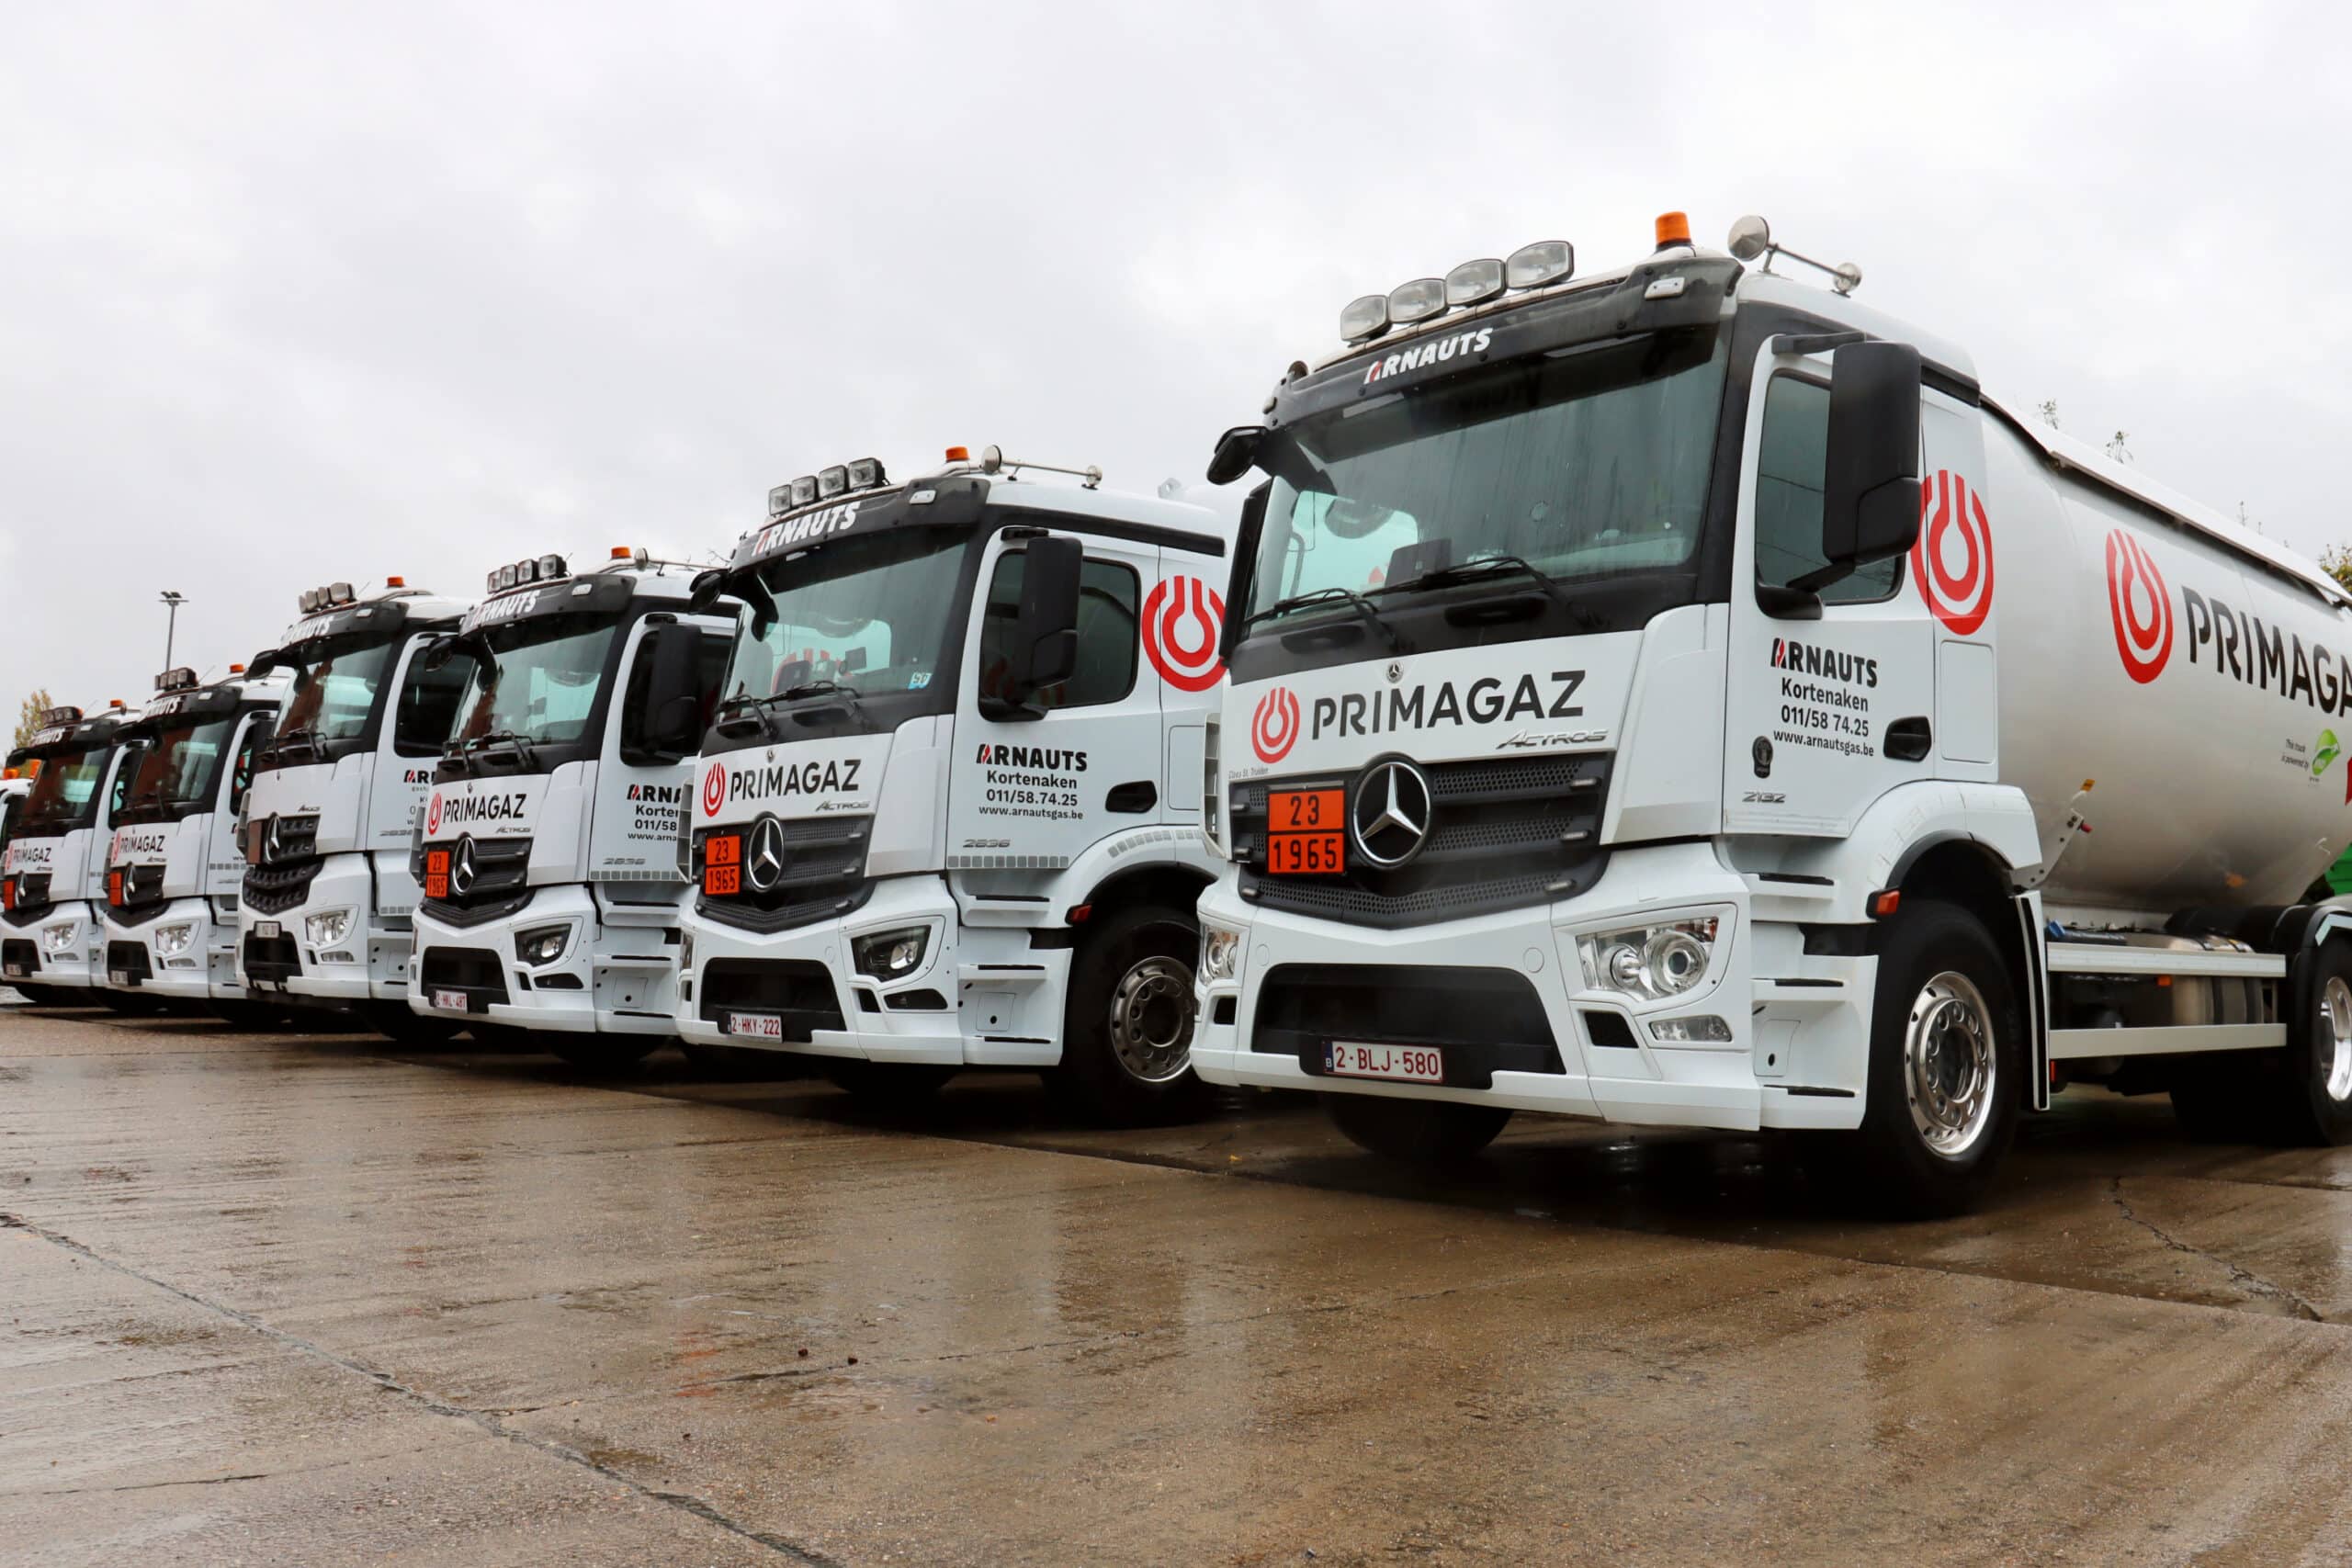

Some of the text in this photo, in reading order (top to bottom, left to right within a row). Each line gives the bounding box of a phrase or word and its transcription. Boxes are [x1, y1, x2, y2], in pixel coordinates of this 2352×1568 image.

[1363, 327, 1494, 385] ARNAUTS
[752, 501, 861, 557] ARNAUTS
[1770, 637, 1878, 688] ARNAUTS
[1312, 670, 1586, 740] PRIMAGAZ
[1781, 677, 1869, 712] Kortenaken
[1781, 705, 1869, 737] 011/58 74.25
[976, 743, 1088, 772] ARNAUTS
[1773, 730, 1874, 757] www.arnautsgas.be
[729, 759, 861, 802] PRIMAGAZ
[987, 770, 1078, 789] Kortenaken
[443, 794, 526, 823] PRIMAGAZ
[986, 789, 1078, 807] 011/58.74.25
[1290, 795, 1319, 826] 23
[978, 806, 1083, 820] www.arnautsgas.be
[120, 835, 164, 852] PRIMAGAZ
[715, 840, 729, 862] 23
[1273, 838, 1337, 870] 1965
[433, 854, 442, 871] 23
[428, 877, 446, 895] 1965
[709, 869, 736, 891] 1965
[1335, 1046, 1439, 1076] 2-BLJ-580
